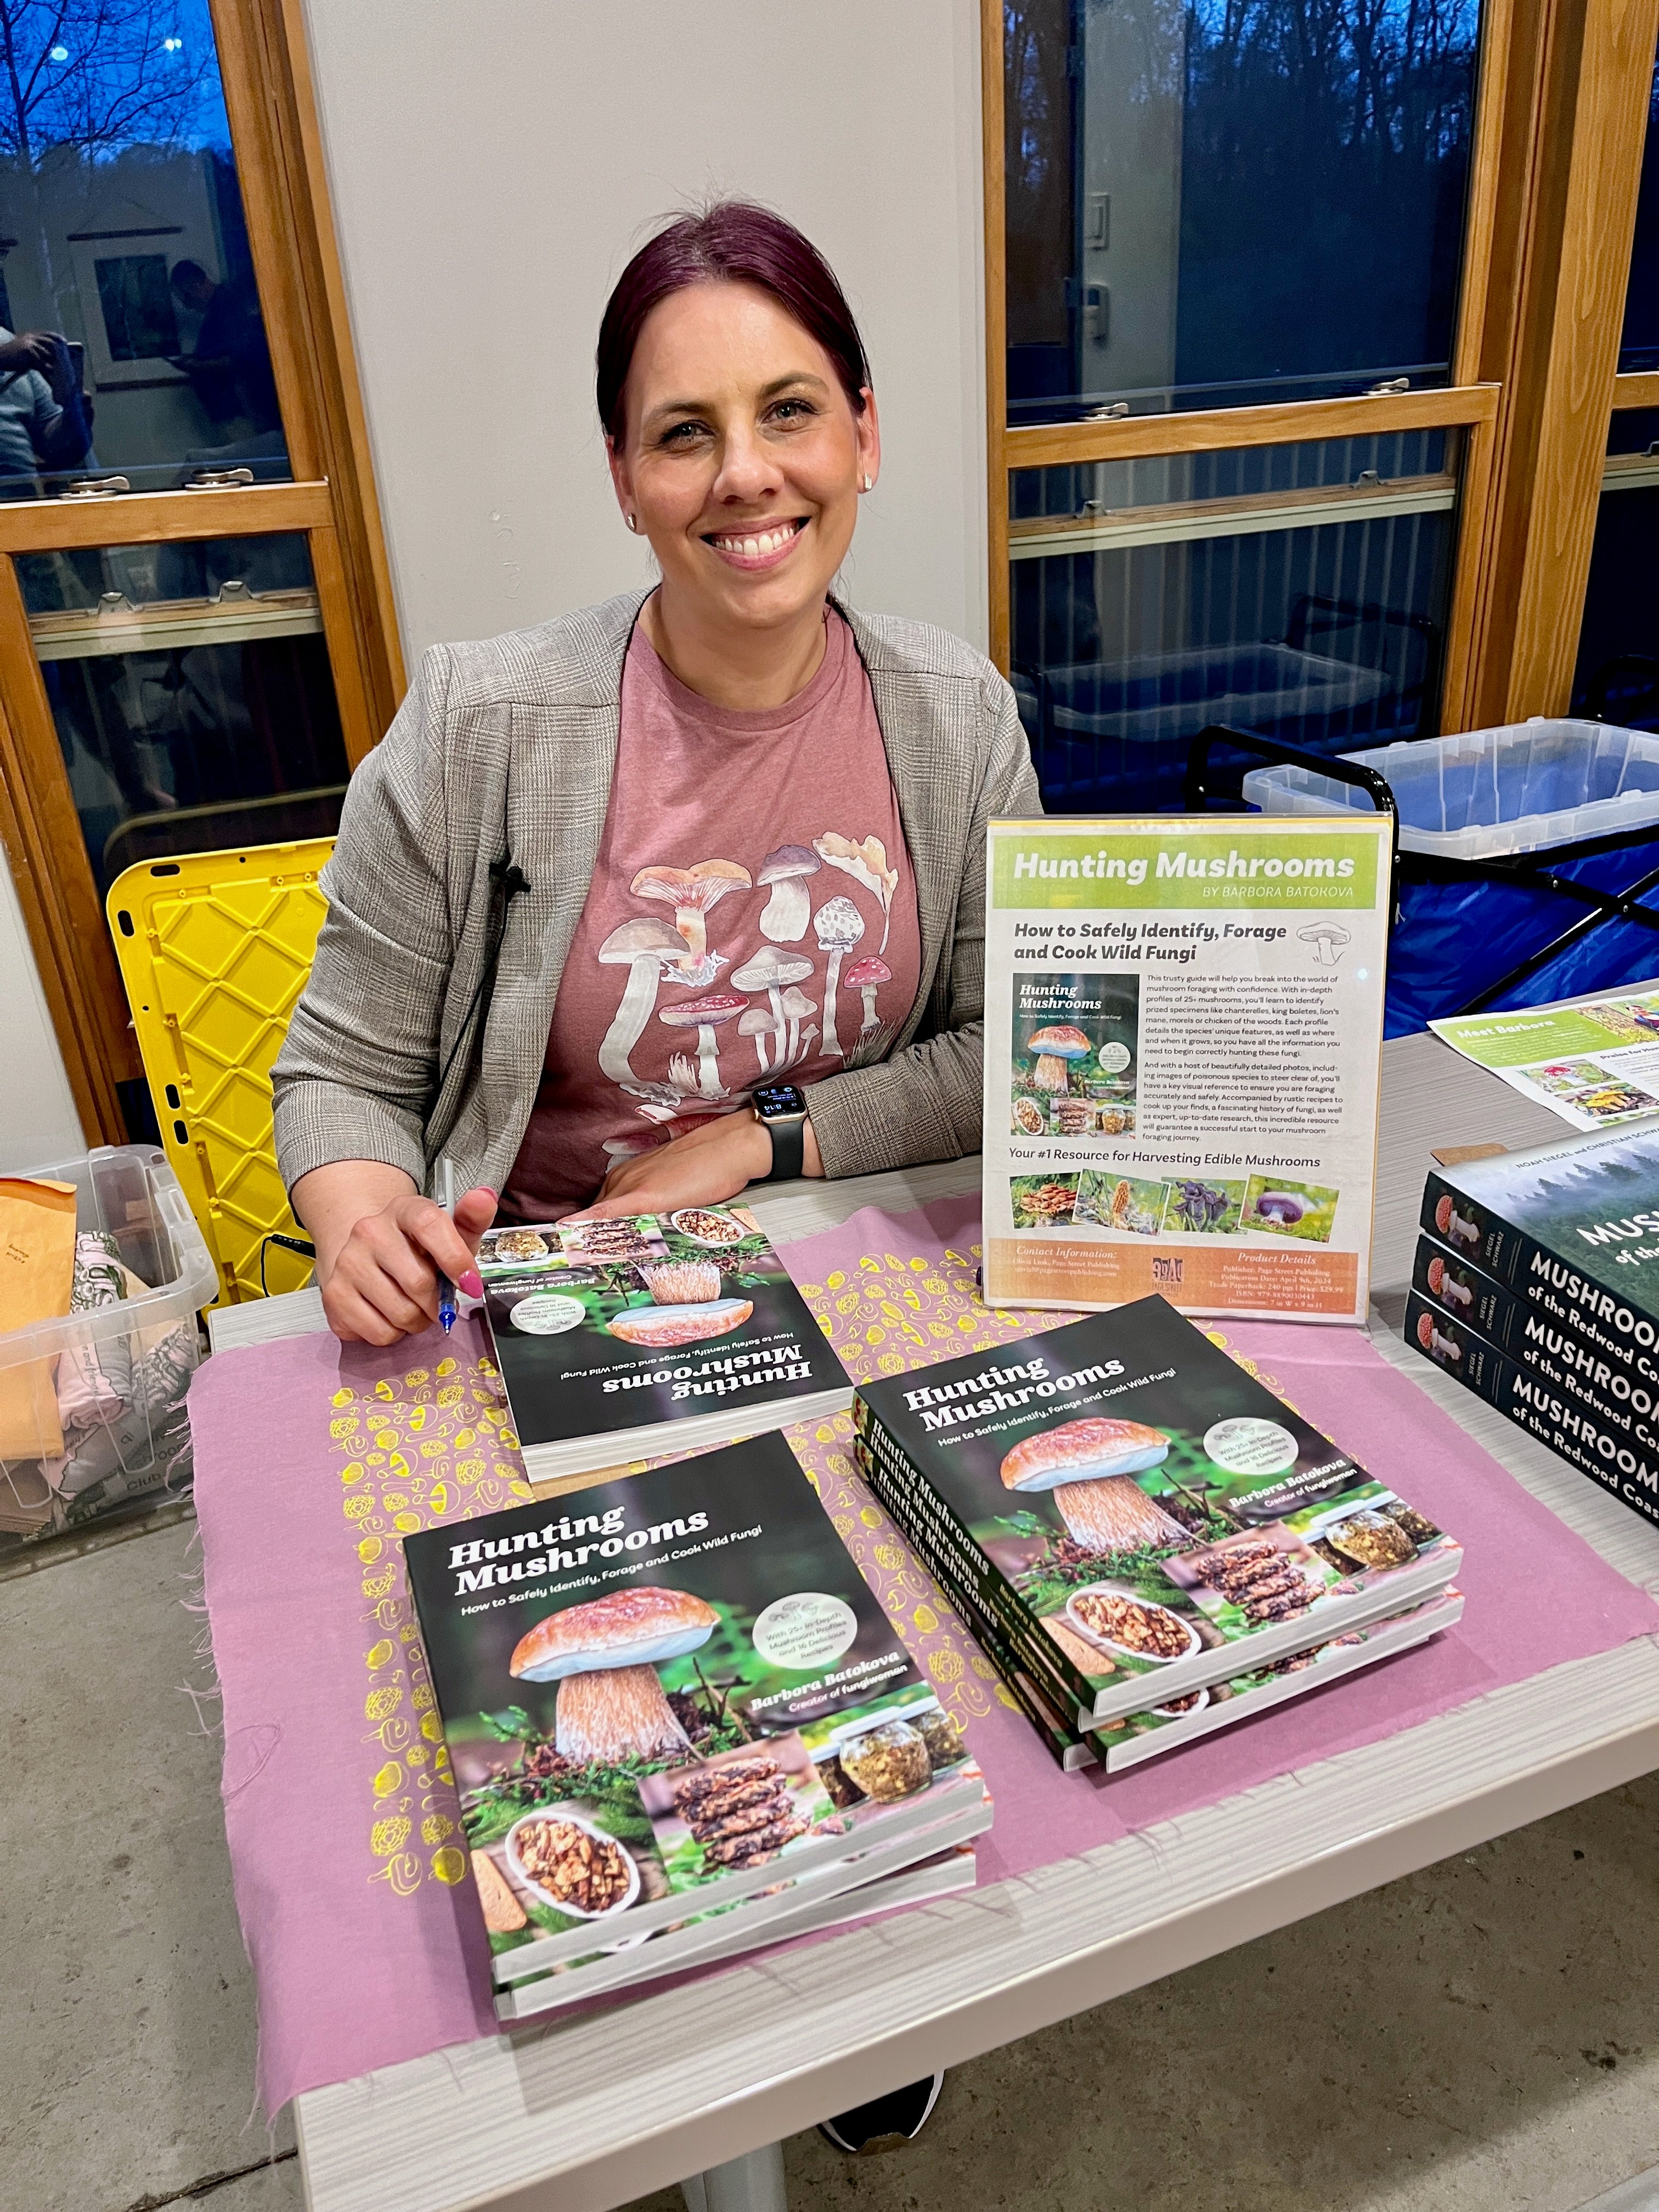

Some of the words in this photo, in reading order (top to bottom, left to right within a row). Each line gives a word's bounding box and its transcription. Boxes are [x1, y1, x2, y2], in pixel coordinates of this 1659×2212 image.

[1014, 850, 1148, 884] Hunting
[1155, 850, 1354, 877] Mushrooms
[1203, 887, 1219, 896] BY
[1222, 886, 1281, 898] BARBORA
[1286, 886, 1354, 897] BATOKOVA
[1014, 923, 1053, 936] How
[1057, 924, 1075, 936] to
[1079, 922, 1137, 941] Safely
[1141, 922, 1218, 941] Identify,
[1223, 923, 1286, 941] Forage
[1014, 944, 1048, 958] and
[1052, 944, 1097, 958] Cook
[1101, 944, 1141, 959] Wild
[1146, 944, 1197, 963] Fungi
[1019, 984, 1078, 997] Hunting
[1019, 997, 1102, 1009] Mushrooms
[1187, 985, 1217, 994] foraging
[1295, 997, 1324, 1005] identify
[1457, 1028, 1496, 1037] Meet
[1494, 1020, 1555, 1033] Barbora
[1009, 1148, 1035, 1158] Your
[1037, 1149, 1051, 1158] #1
[1054, 1149, 1109, 1160] Resource
[1113, 1150, 1130, 1160] for
[1132, 1152, 1201, 1166] Harvesting
[1204, 1153, 1242, 1164] Edible
[1245, 1154, 1320, 1166] Mushrooms
[1516, 1160, 1542, 1168] NOAH
[1543, 1152, 1574, 1163] SIEGEL
[1587, 1136, 1632, 1151] CHRISTIAN
[1017, 1245, 1053, 1255] Contact
[1056, 1246, 1116, 1259] Information:
[1238, 1252, 1277, 1262] Product
[1279, 1254, 1316, 1264] Details
[1486, 1233, 1496, 1257] SIEGEL
[1491, 1231, 1504, 1267] SCHWARZ
[1615, 1250, 1640, 1266] of
[546, 1277, 597, 1288] Barbora
[1295, 1268, 1330, 1277] Publishing
[489, 1284, 544, 1294] Batokova
[1530, 1251, 1659, 1353] MUSHROO
[1479, 1296, 1488, 1319] SIEGEL
[1487, 1295, 1497, 1330] SCHWARZ
[691, 1345, 730, 1356] Identify,
[731, 1339, 760, 1348] Safely
[1528, 1287, 1544, 1301] of
[1544, 1295, 1565, 1318] the
[1568, 1308, 1634, 1365] Redwood
[1637, 1357, 1659, 1383] Co
[589, 1367, 610, 1375] Wild
[602, 1344, 803, 1394] Mushrooms
[612, 1362, 636, 1371] Cook
[638, 1358, 657, 1367] and
[658, 1352, 690, 1362] Forage
[1476, 1352, 1485, 1386] SCHWARZ
[561, 1370, 586, 1380] Fungi
[671, 1361, 812, 1401] Hunting
[902, 1358, 1049, 1412] Hunting
[919, 1359, 1125, 1431] Mushrooms
[938, 1435, 961, 1446] How
[974, 1423, 1007, 1436] Safely
[1007, 1408, 1049, 1426] Identify,
[1047, 1399, 1084, 1414] Forage
[1083, 1391, 1104, 1403] and
[1103, 1383, 1129, 1396] Cook
[1128, 1375, 1152, 1388] Wild
[1150, 1368, 1176, 1381] Fungi
[1523, 1351, 1539, 1365] of
[1541, 1359, 1562, 1383] the
[1565, 1373, 1632, 1430] Redwood
[1635, 1424, 1659, 1453] Co
[1513, 1407, 1527, 1421] of
[1529, 1417, 1550, 1440] the
[1554, 1431, 1618, 1488] Redwood
[872, 1418, 917, 1487] Hunting
[918, 1475, 990, 1576] Mushrooms
[1229, 1482, 1285, 1509] Barbora
[1286, 1459, 1346, 1487] Batokova
[1264, 1492, 1295, 1506] Creator
[1296, 1487, 1305, 1496] of
[1304, 1469, 1357, 1492] fungiwoman
[870, 1432, 911, 1499] Hunting
[913, 1490, 979, 1590] Mushrooms
[448, 1506, 625, 1569] Hunting
[878, 1468, 924, 1532] Hunting
[926, 1525, 998, 1629] Mushrooms
[455, 1512, 709, 1596] Mushrooms
[461, 1602, 489, 1616] How
[492, 1599, 506, 1607] to
[508, 1588, 547, 1603] Safely
[550, 1575, 600, 1593] Identify,
[602, 1563, 642, 1579] Forage
[645, 1553, 669, 1567] and
[671, 1544, 701, 1559] Cook
[702, 1534, 729, 1549] Wild
[730, 1524, 762, 1541] Fungi
[910, 1528, 971, 1628] Mushrooms
[751, 1680, 822, 1712] Barbora
[824, 1651, 900, 1686] Batokova
[789, 1692, 827, 1712] Creator
[830, 1686, 839, 1698] of
[841, 1664, 907, 1694] fungiwoman
